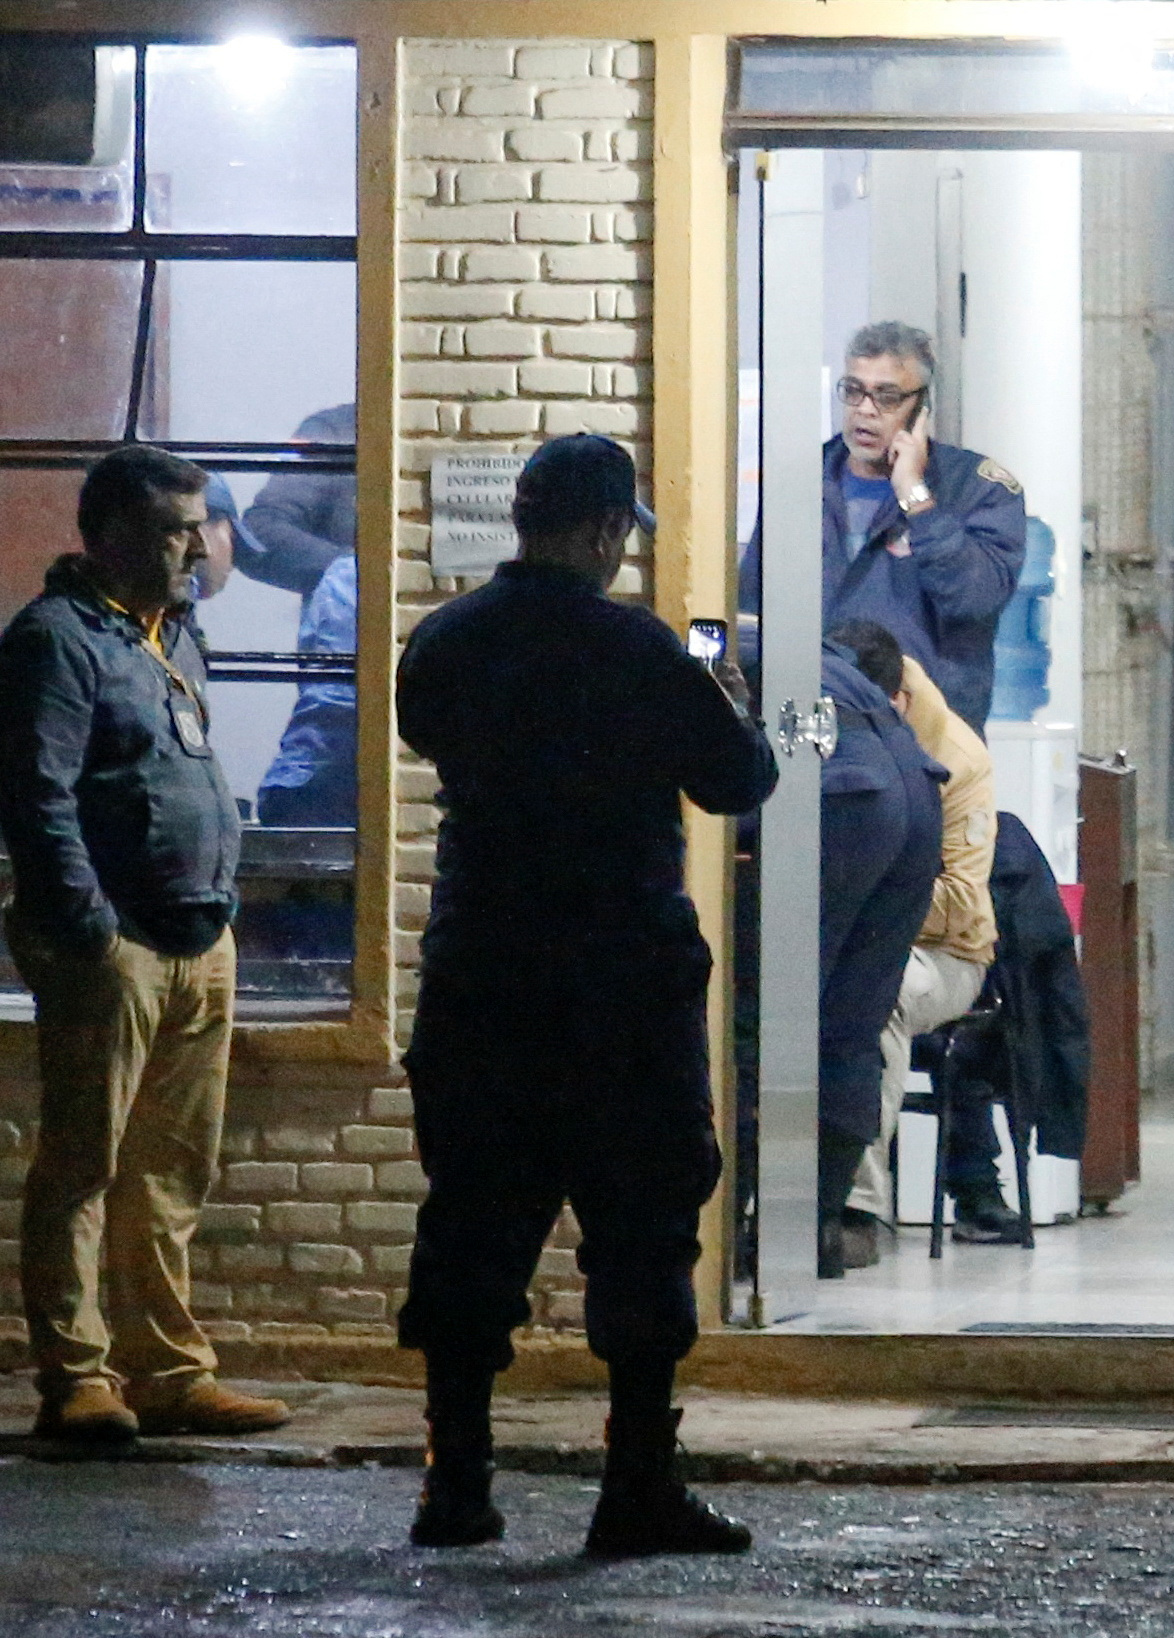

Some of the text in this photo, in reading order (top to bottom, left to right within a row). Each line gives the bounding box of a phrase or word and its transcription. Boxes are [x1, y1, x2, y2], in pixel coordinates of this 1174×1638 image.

[447, 458, 526, 470] PROHIBIDO
[447, 476, 511, 488] INGRESO
[448, 531, 514, 542] NO INSIST
